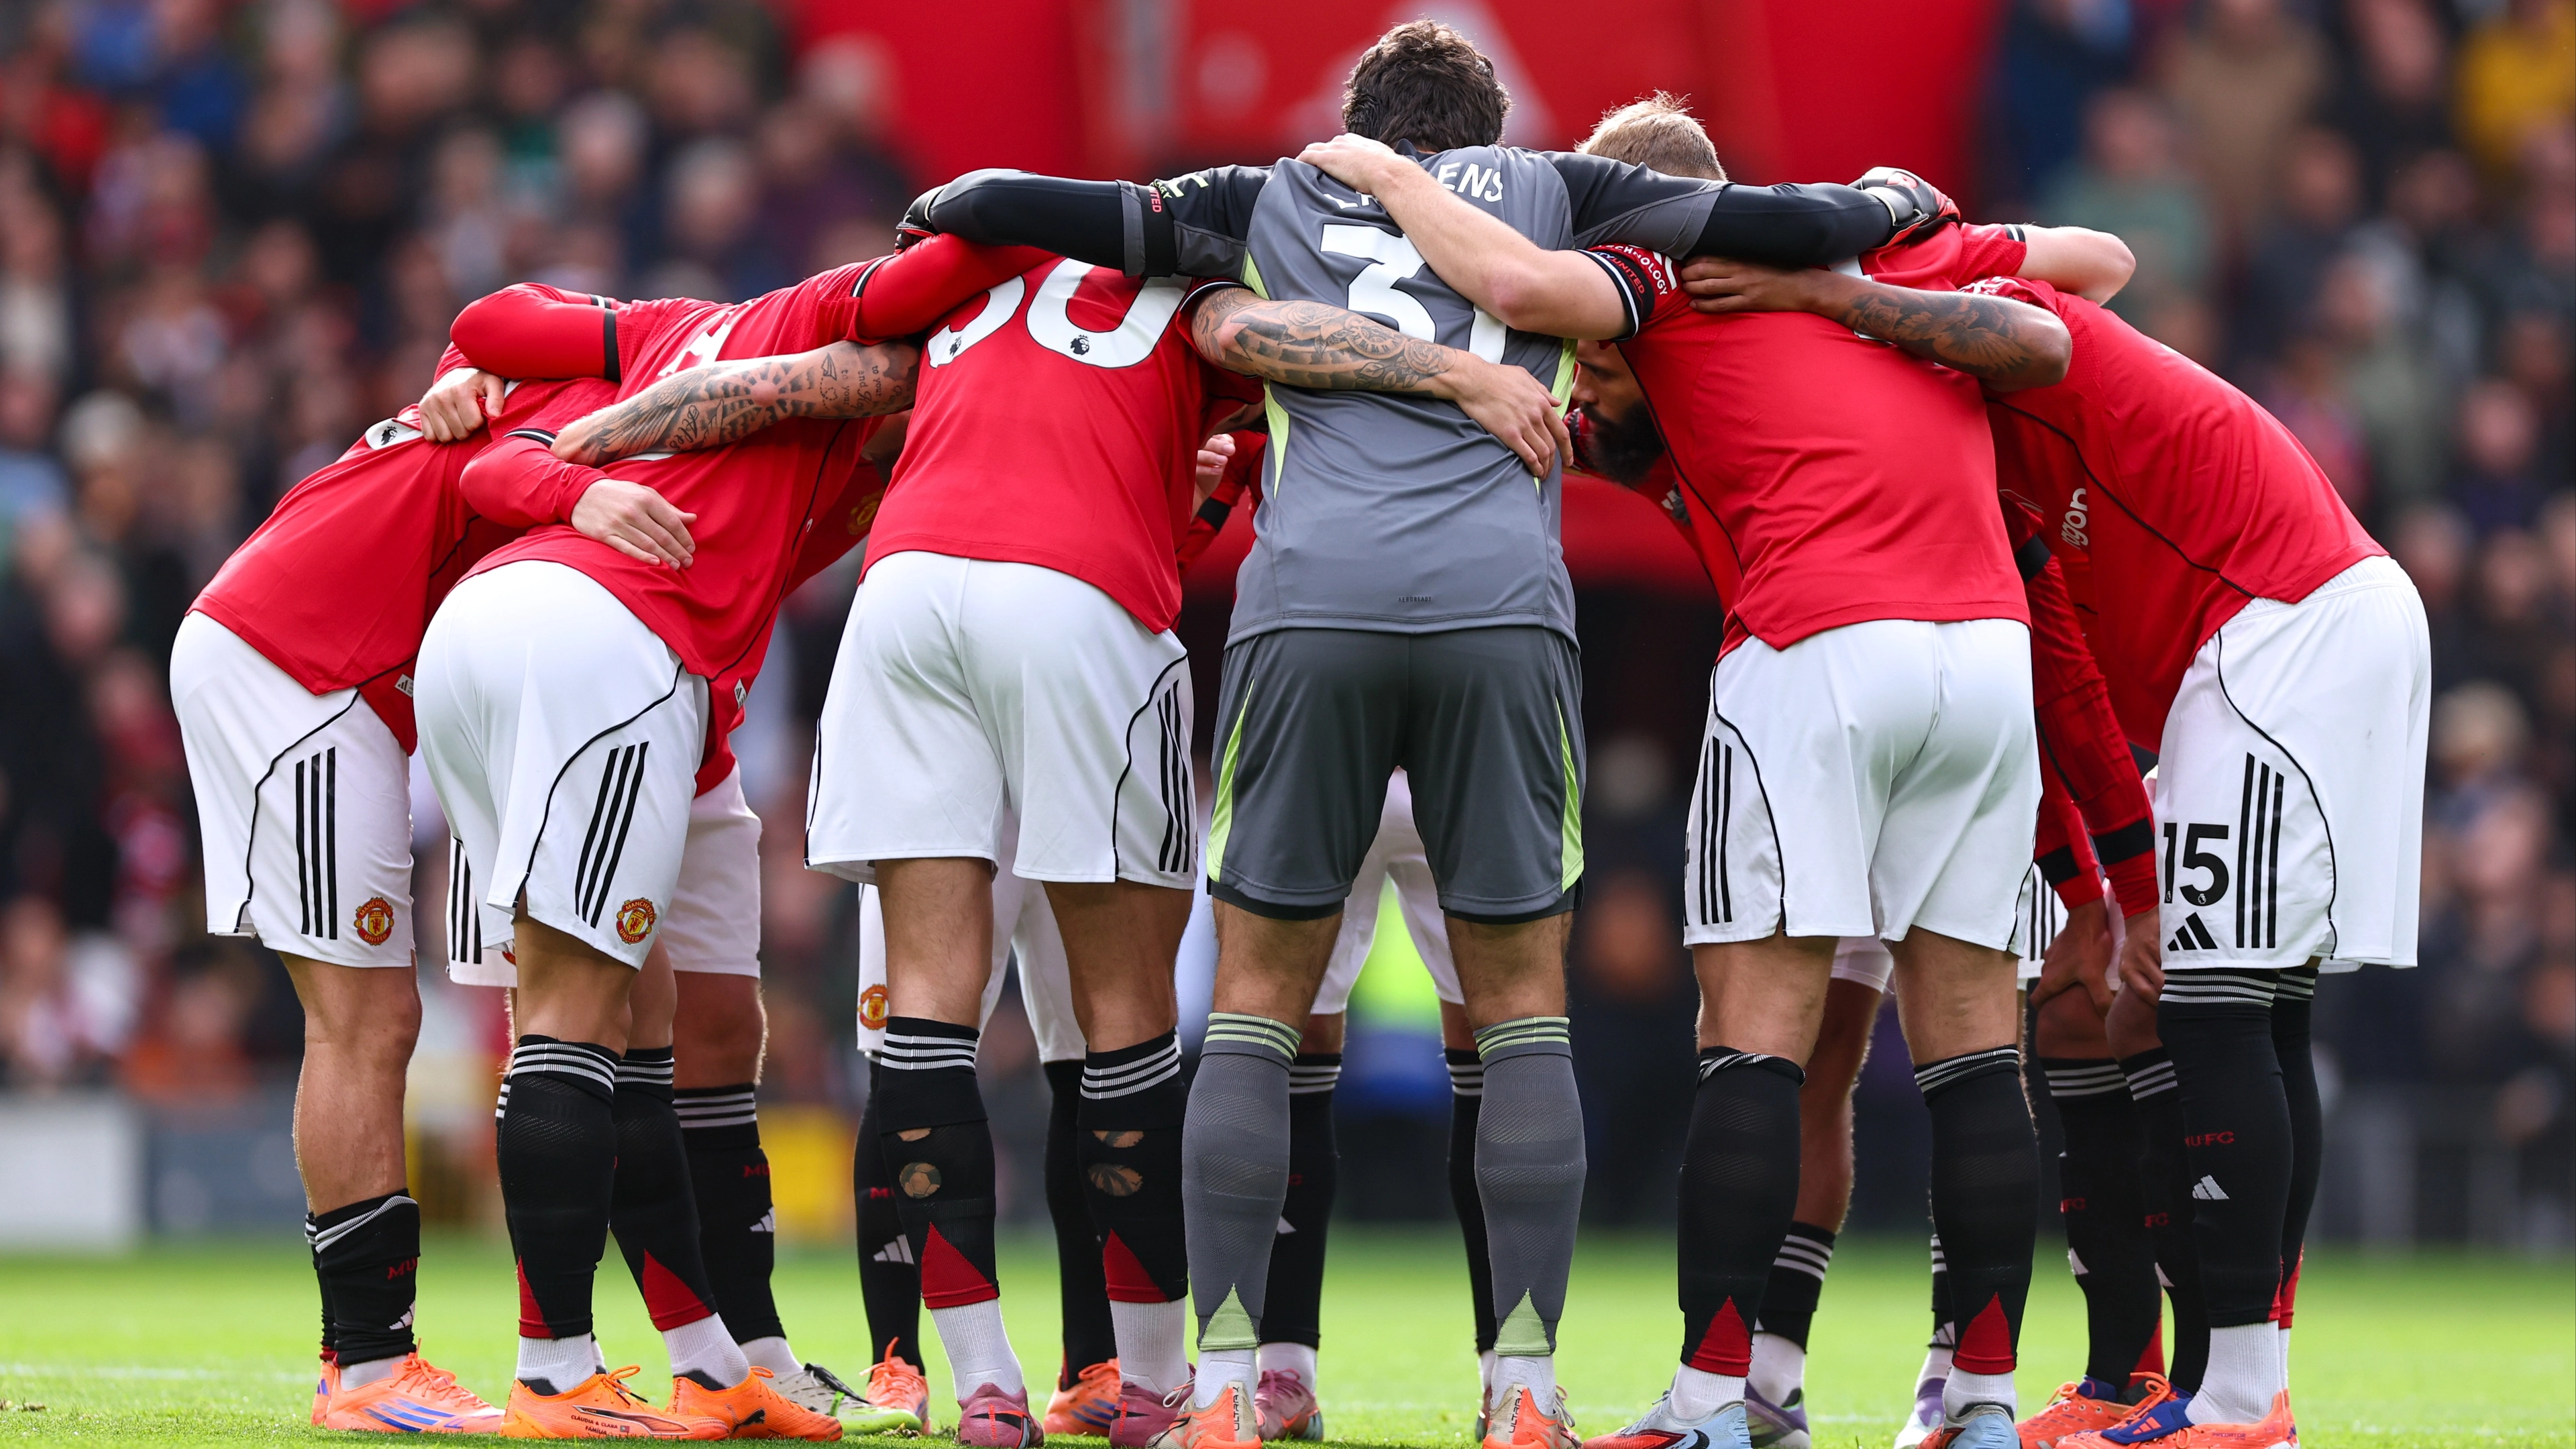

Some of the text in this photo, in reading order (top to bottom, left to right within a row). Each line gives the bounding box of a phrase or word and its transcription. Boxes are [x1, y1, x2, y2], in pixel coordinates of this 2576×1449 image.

[2163, 822, 2229, 907] 15
[359, 900, 392, 917] MANCHESTER
[625, 901, 654, 922] MANCHESTER
[364, 933, 387, 942] UNITED
[619, 928, 639, 941] UNITED
